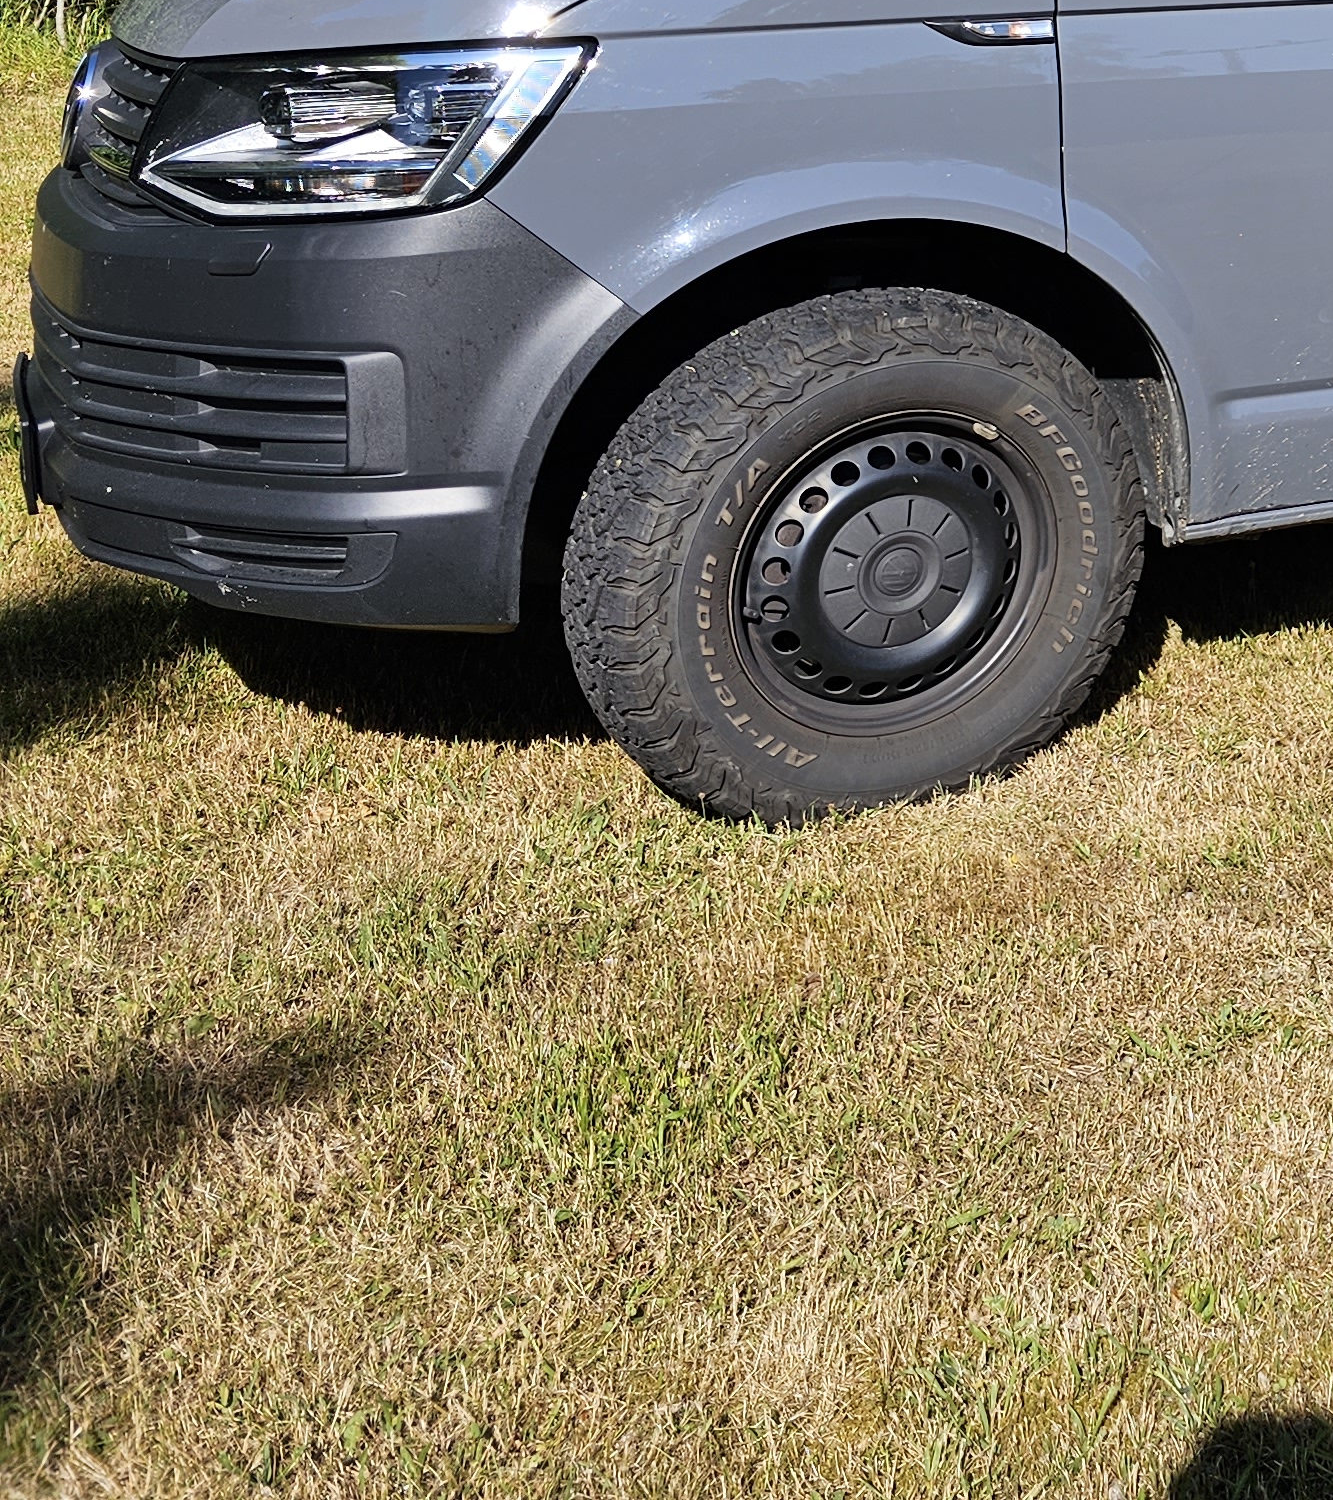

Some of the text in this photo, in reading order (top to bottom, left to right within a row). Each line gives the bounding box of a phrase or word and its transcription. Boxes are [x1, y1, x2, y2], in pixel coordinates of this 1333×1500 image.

[714, 457, 772, 527] T/A
[1014, 403, 1099, 654] BFGoodrich
[694, 553, 819, 768] All-Terrain
